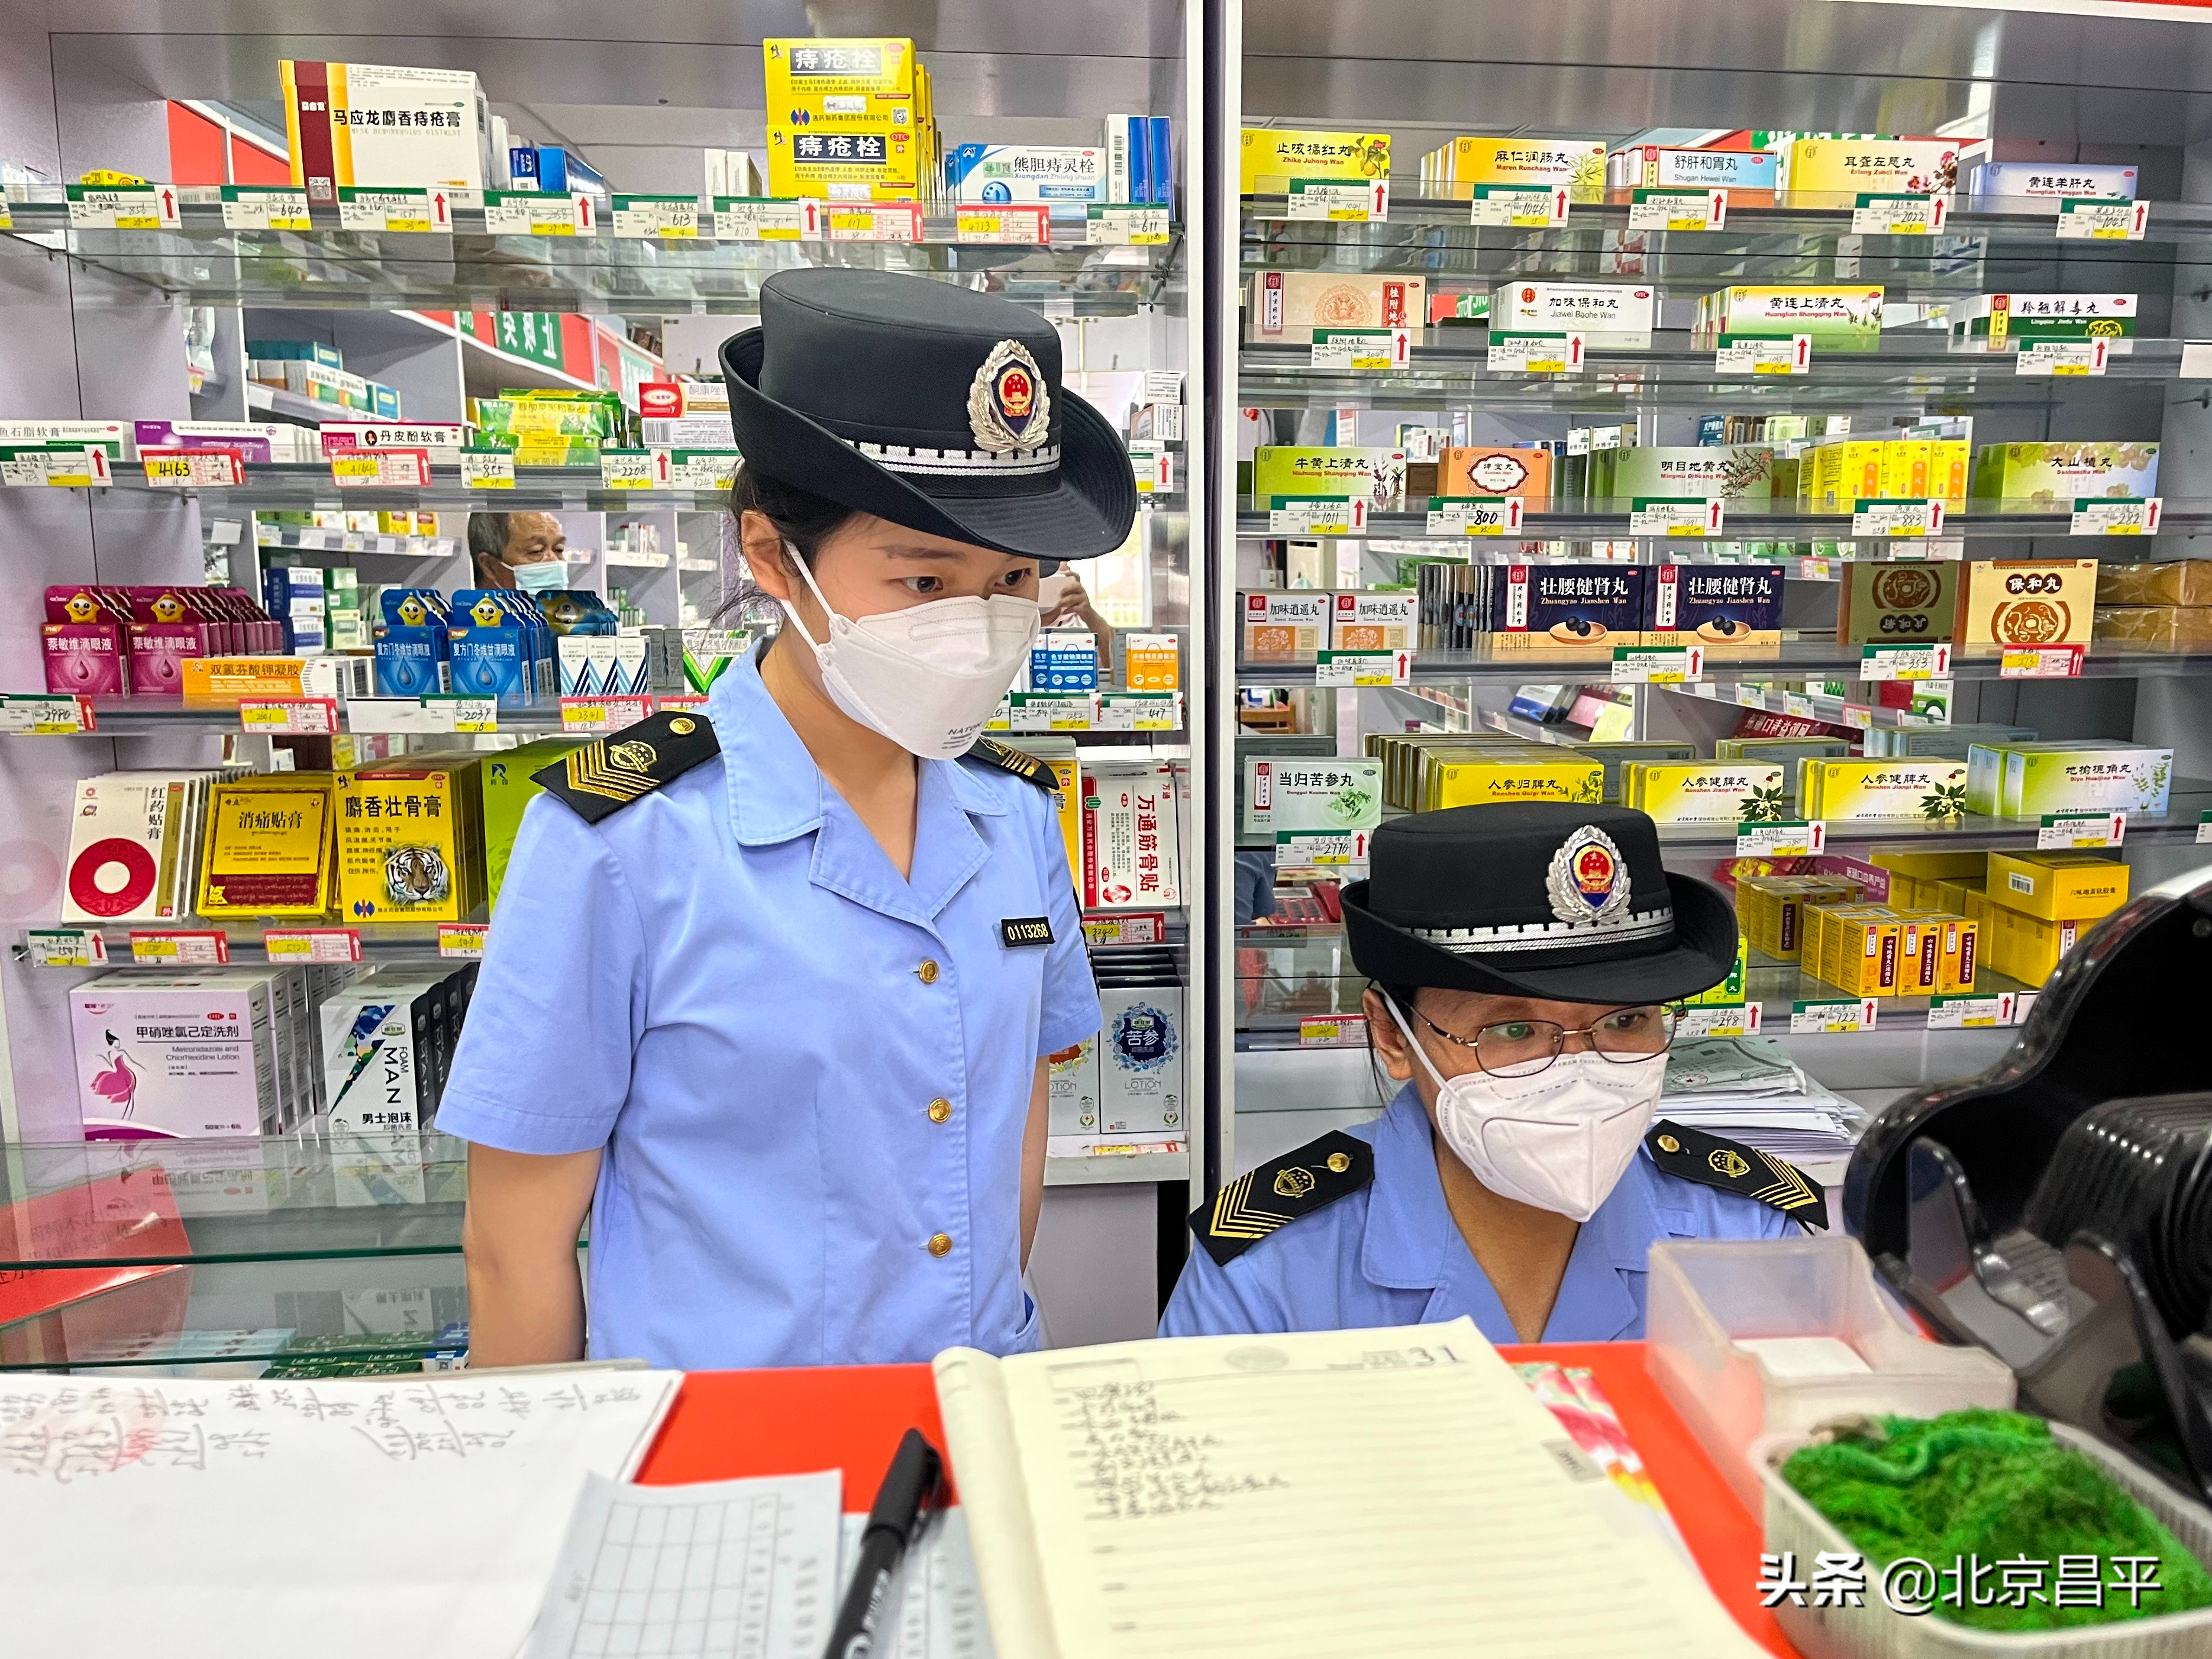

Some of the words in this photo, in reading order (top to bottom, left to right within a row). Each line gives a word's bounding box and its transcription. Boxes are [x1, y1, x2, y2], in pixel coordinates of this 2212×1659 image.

[795, 49, 877, 69] 痔疮栓
[333, 109, 461, 128] 马应龙麝香痔疮膏
[799, 135, 881, 157] 痔疮栓
[1276, 142, 1351, 157] 止咳橘红丸
[1304, 157, 1329, 166] Juhong
[1494, 150, 1569, 164] 麻仁润肠丸
[1674, 155, 1738, 171] 舒肝和胃丸
[1014, 156, 1095, 173] 熊胆痔灵栓
[1519, 164, 1551, 173] Runchang
[1674, 173, 1698, 183] Shugan
[2029, 176, 2095, 189] 黄连羊肝丸
[281, 204, 302, 217] 640
[1523, 202, 1545, 215] 1046
[673, 215, 691, 227] 613
[1901, 211, 1925, 222] 2022
[1142, 219, 1158, 232] 611
[1549, 298, 1619, 309] 加味保和丸
[1769, 297, 1845, 309] 黄连上清丸
[379, 430, 446, 444] 丹皮酚软膏
[159, 461, 190, 477] 4163
[1294, 457, 1368, 469] 牛黄上清丸
[1661, 461, 1730, 472] 明目地黄丸
[622, 464, 647, 477] 2208
[1474, 510, 1497, 525] 800
[1902, 514, 1922, 526] 883
[2117, 513, 2140, 525] 282
[1540, 577, 1628, 595] 壮腰健肾丸
[1688, 577, 1772, 595] 壮腰健肾丸
[2008, 577, 2061, 592] 保和丸
[1541, 596, 1577, 605] Zhuangyao
[1689, 596, 1723, 605] Zhuangyao
[1270, 603, 1319, 615] 加味逍遥丸
[1358, 603, 1409, 615] 加味逍遥丸
[1909, 658, 1928, 669] 353
[1279, 772, 1354, 787] 当归苦参丸
[1488, 779, 1559, 790] 人参归脾丸
[1682, 776, 1749, 787] 人参健脾丸
[1861, 774, 1930, 784] 人参健脾丸
[345, 795, 442, 818] 麝香壮骨膏
[147, 787, 166, 840] 红药贴膏
[238, 811, 303, 830] 消痛贴膏
[1137, 795, 1160, 892] 万通筋骨贴
[1323, 843, 1348, 856] 2770
[1007, 923, 1048, 941] 0113268
[1718, 1016, 1739, 1027] 298
[1837, 1012, 1856, 1024] 722
[137, 1025, 238, 1038] 甲硝唑氯己定洗剂
[1126, 1029, 1160, 1046] 苦参
[399, 1047, 409, 1073] FOAM
[383, 1047, 401, 1104] MAN
[1049, 1082, 1077, 1090] OTION
[1125, 1081, 1161, 1090] LOTION
[362, 1112, 412, 1124] 男士泡沫
